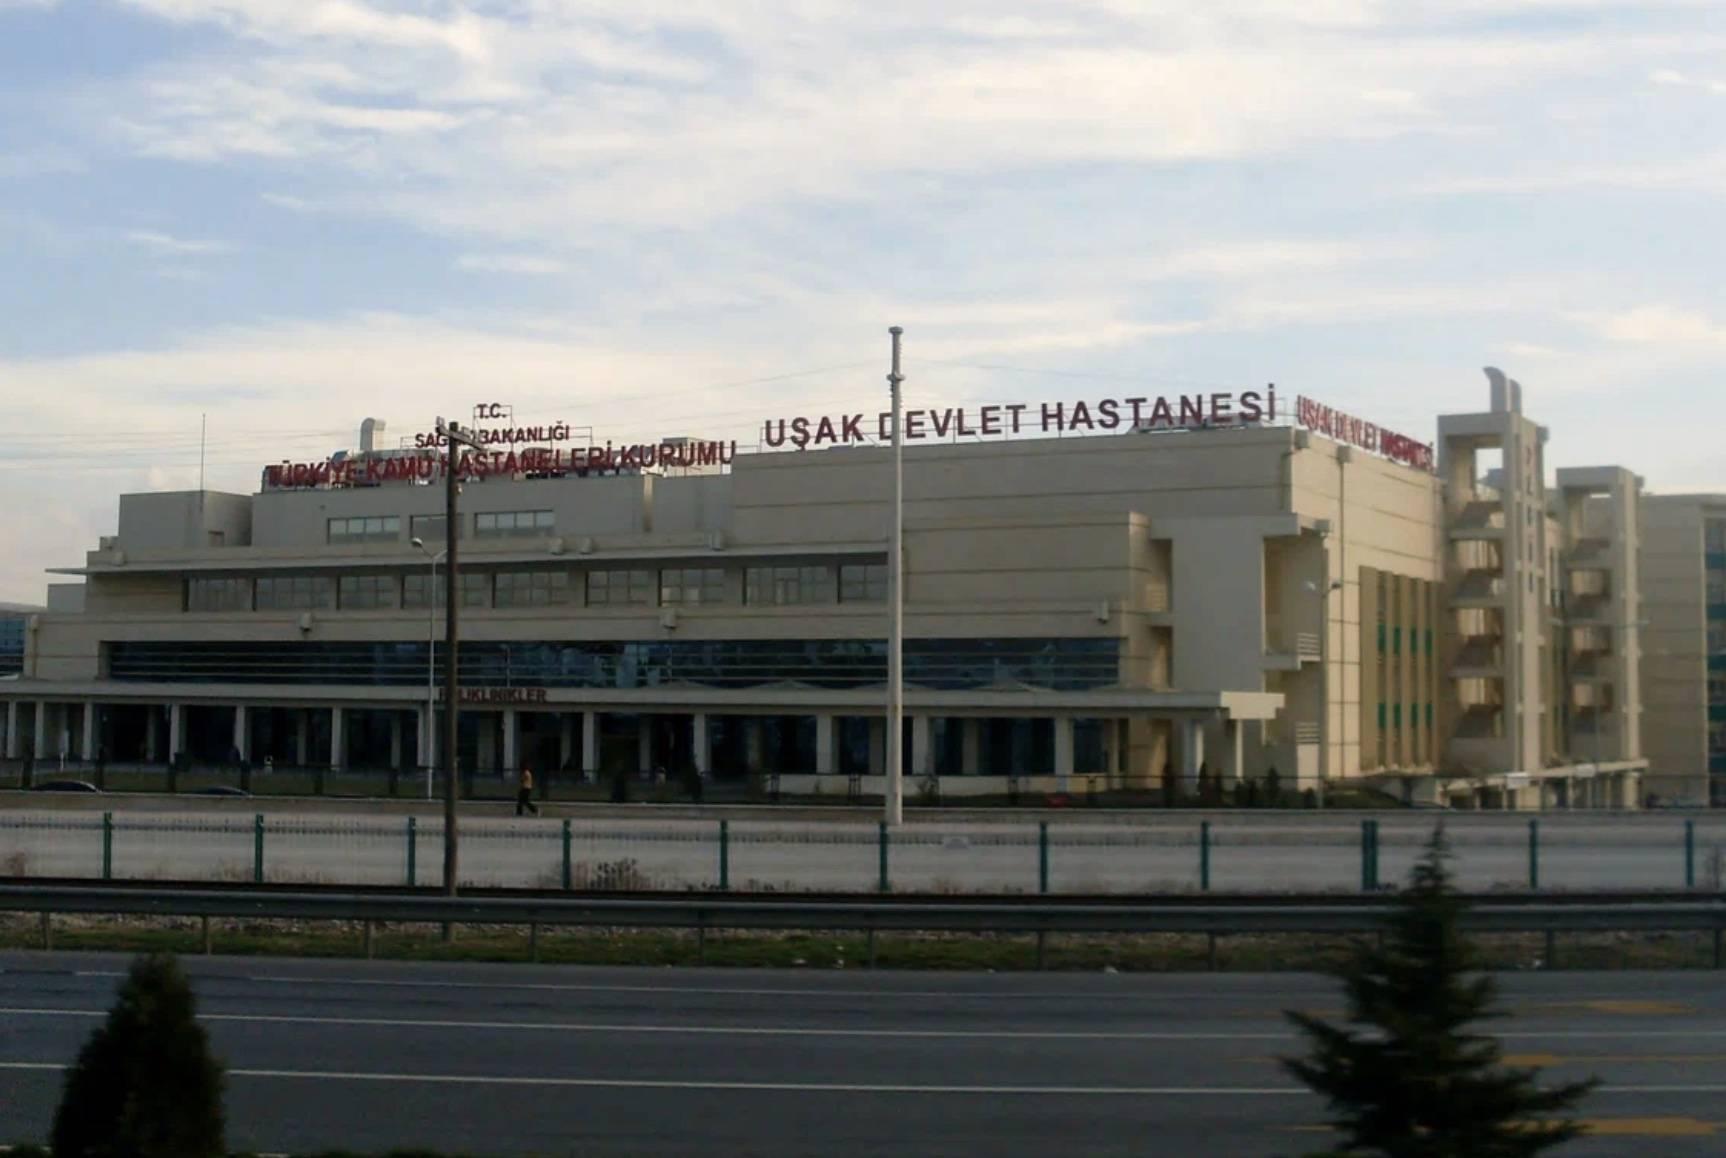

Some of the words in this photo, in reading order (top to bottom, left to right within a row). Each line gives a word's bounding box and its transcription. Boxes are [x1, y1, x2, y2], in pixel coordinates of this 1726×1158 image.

[477, 403, 507, 419] T.C.
[765, 413, 864, 450] UŞAK
[878, 404, 1027, 440] DEVLET
[1041, 383, 1276, 432] HASTANESİ
[479, 420, 570, 444] BAKANLIĞI
[266, 456, 358, 487] TÜRKİYE
[367, 454, 434, 481] KAMU
[620, 440, 736, 468] KURUMU
